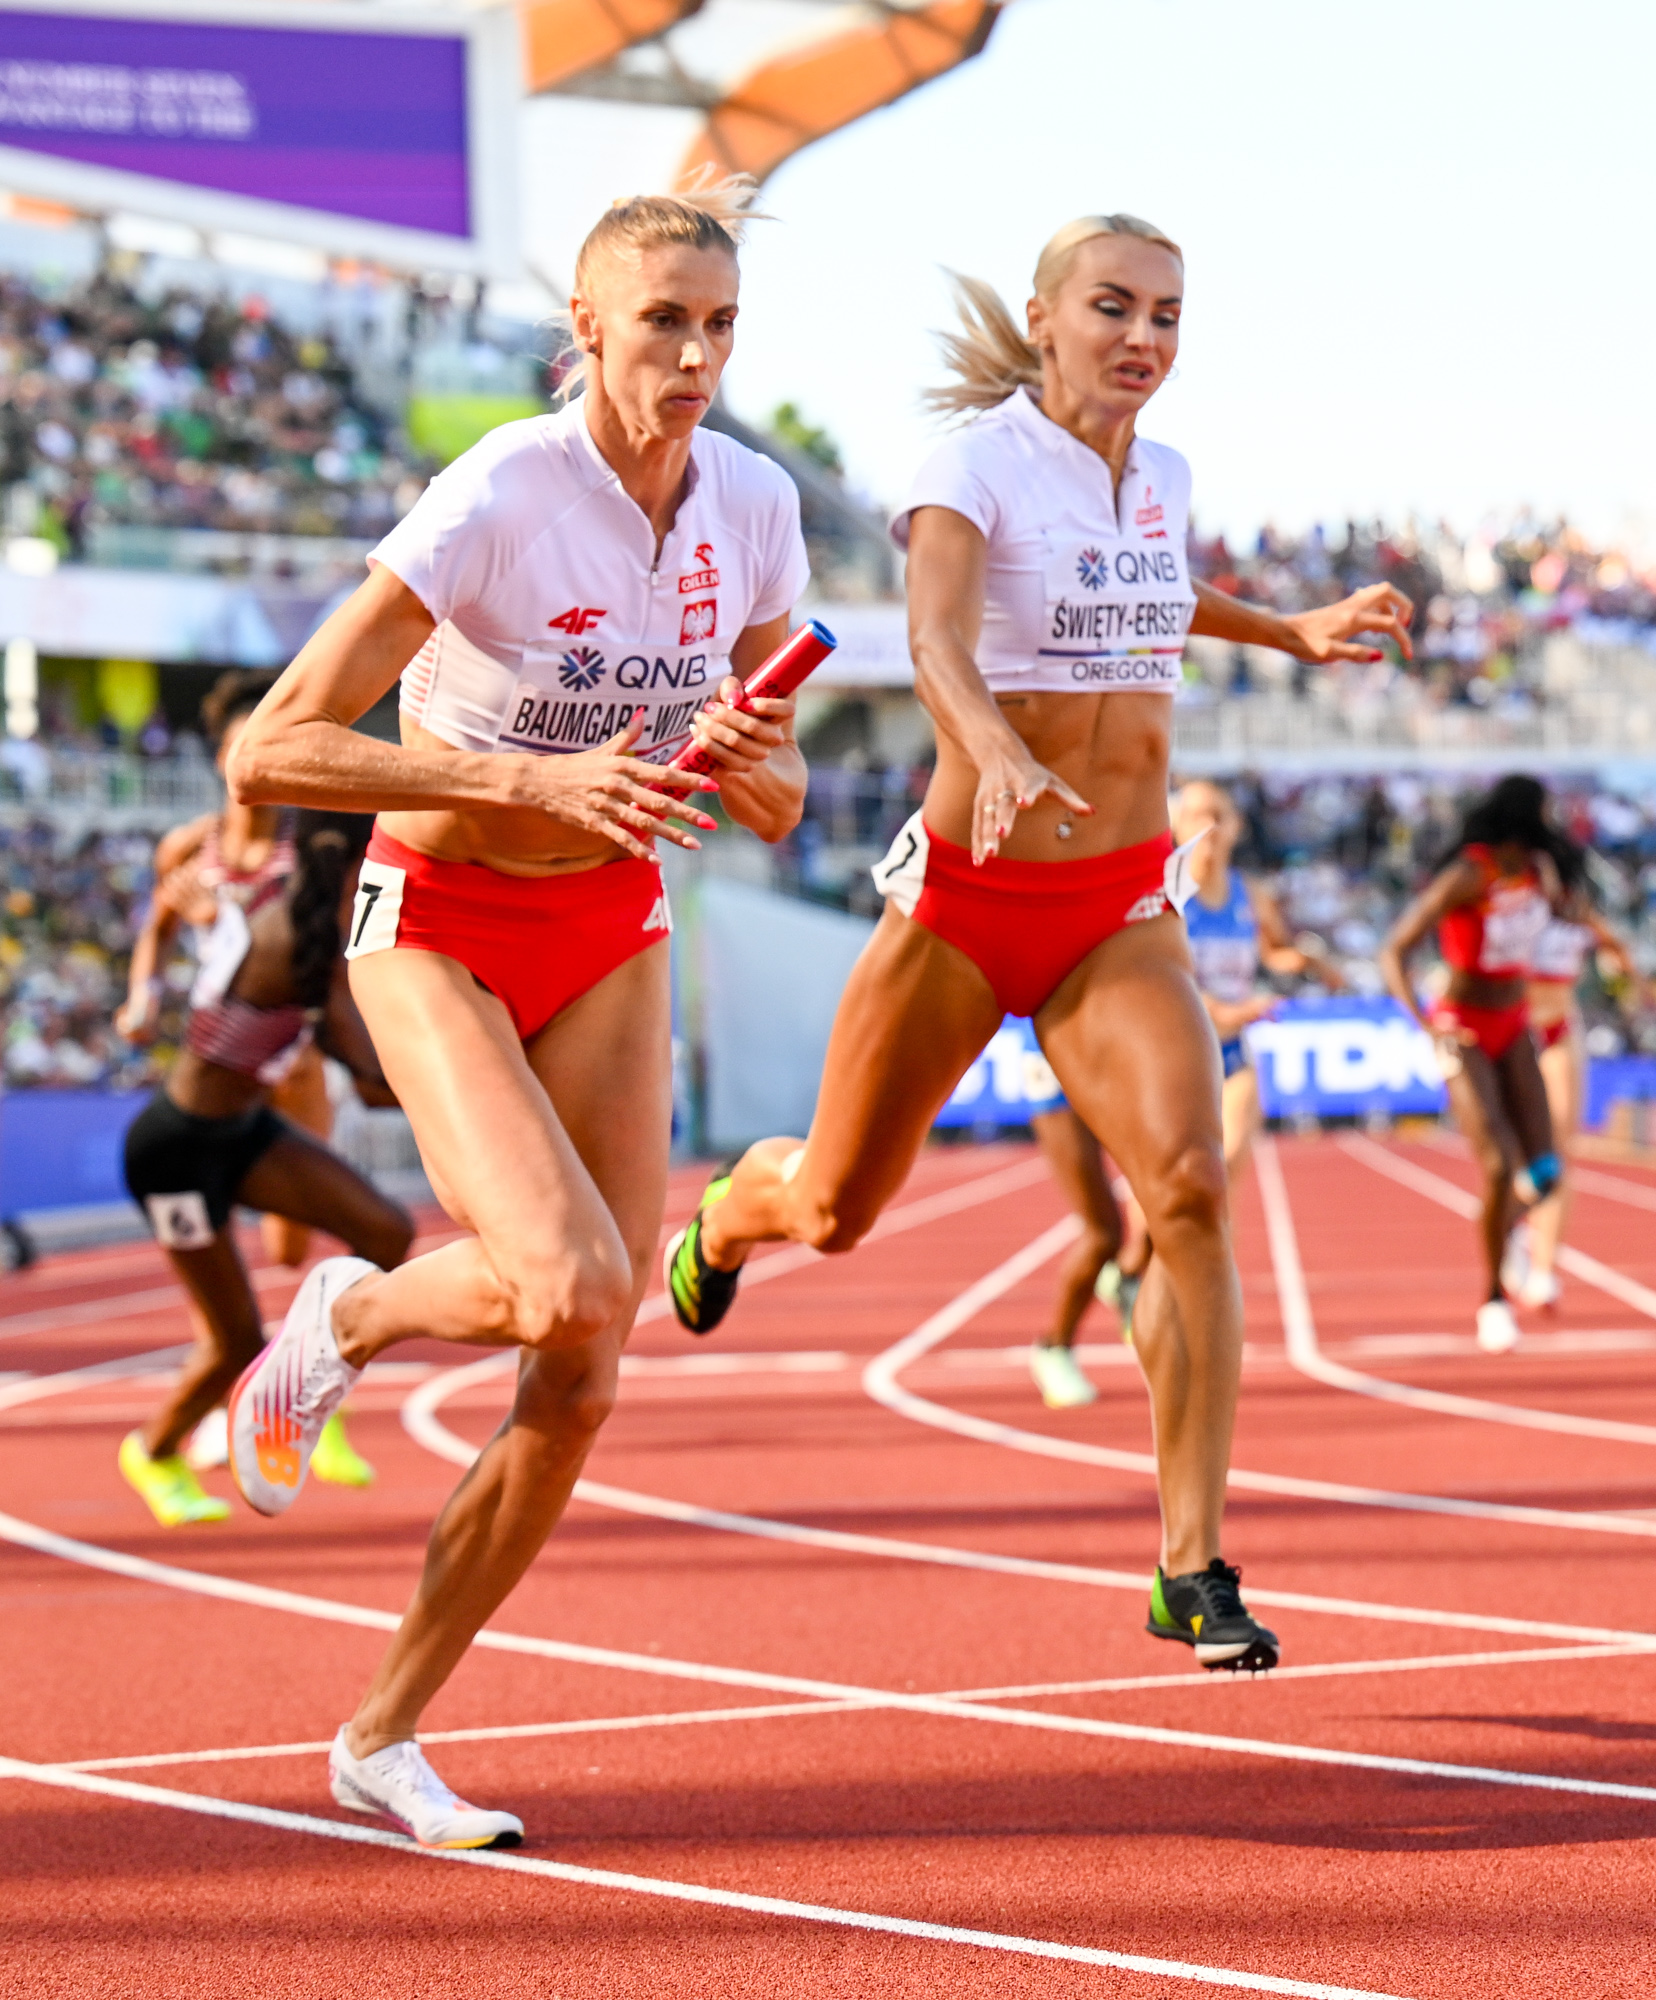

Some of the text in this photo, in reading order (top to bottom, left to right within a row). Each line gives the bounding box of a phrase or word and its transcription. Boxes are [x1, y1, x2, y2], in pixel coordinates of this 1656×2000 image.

[1115, 551, 1178, 584] QNB
[548, 606, 607, 636] 4F
[615, 654, 706, 689] QNB
[885, 832, 917, 878] 7
[354, 882, 383, 948] 7
[1243, 1018, 1436, 1094] TDK
